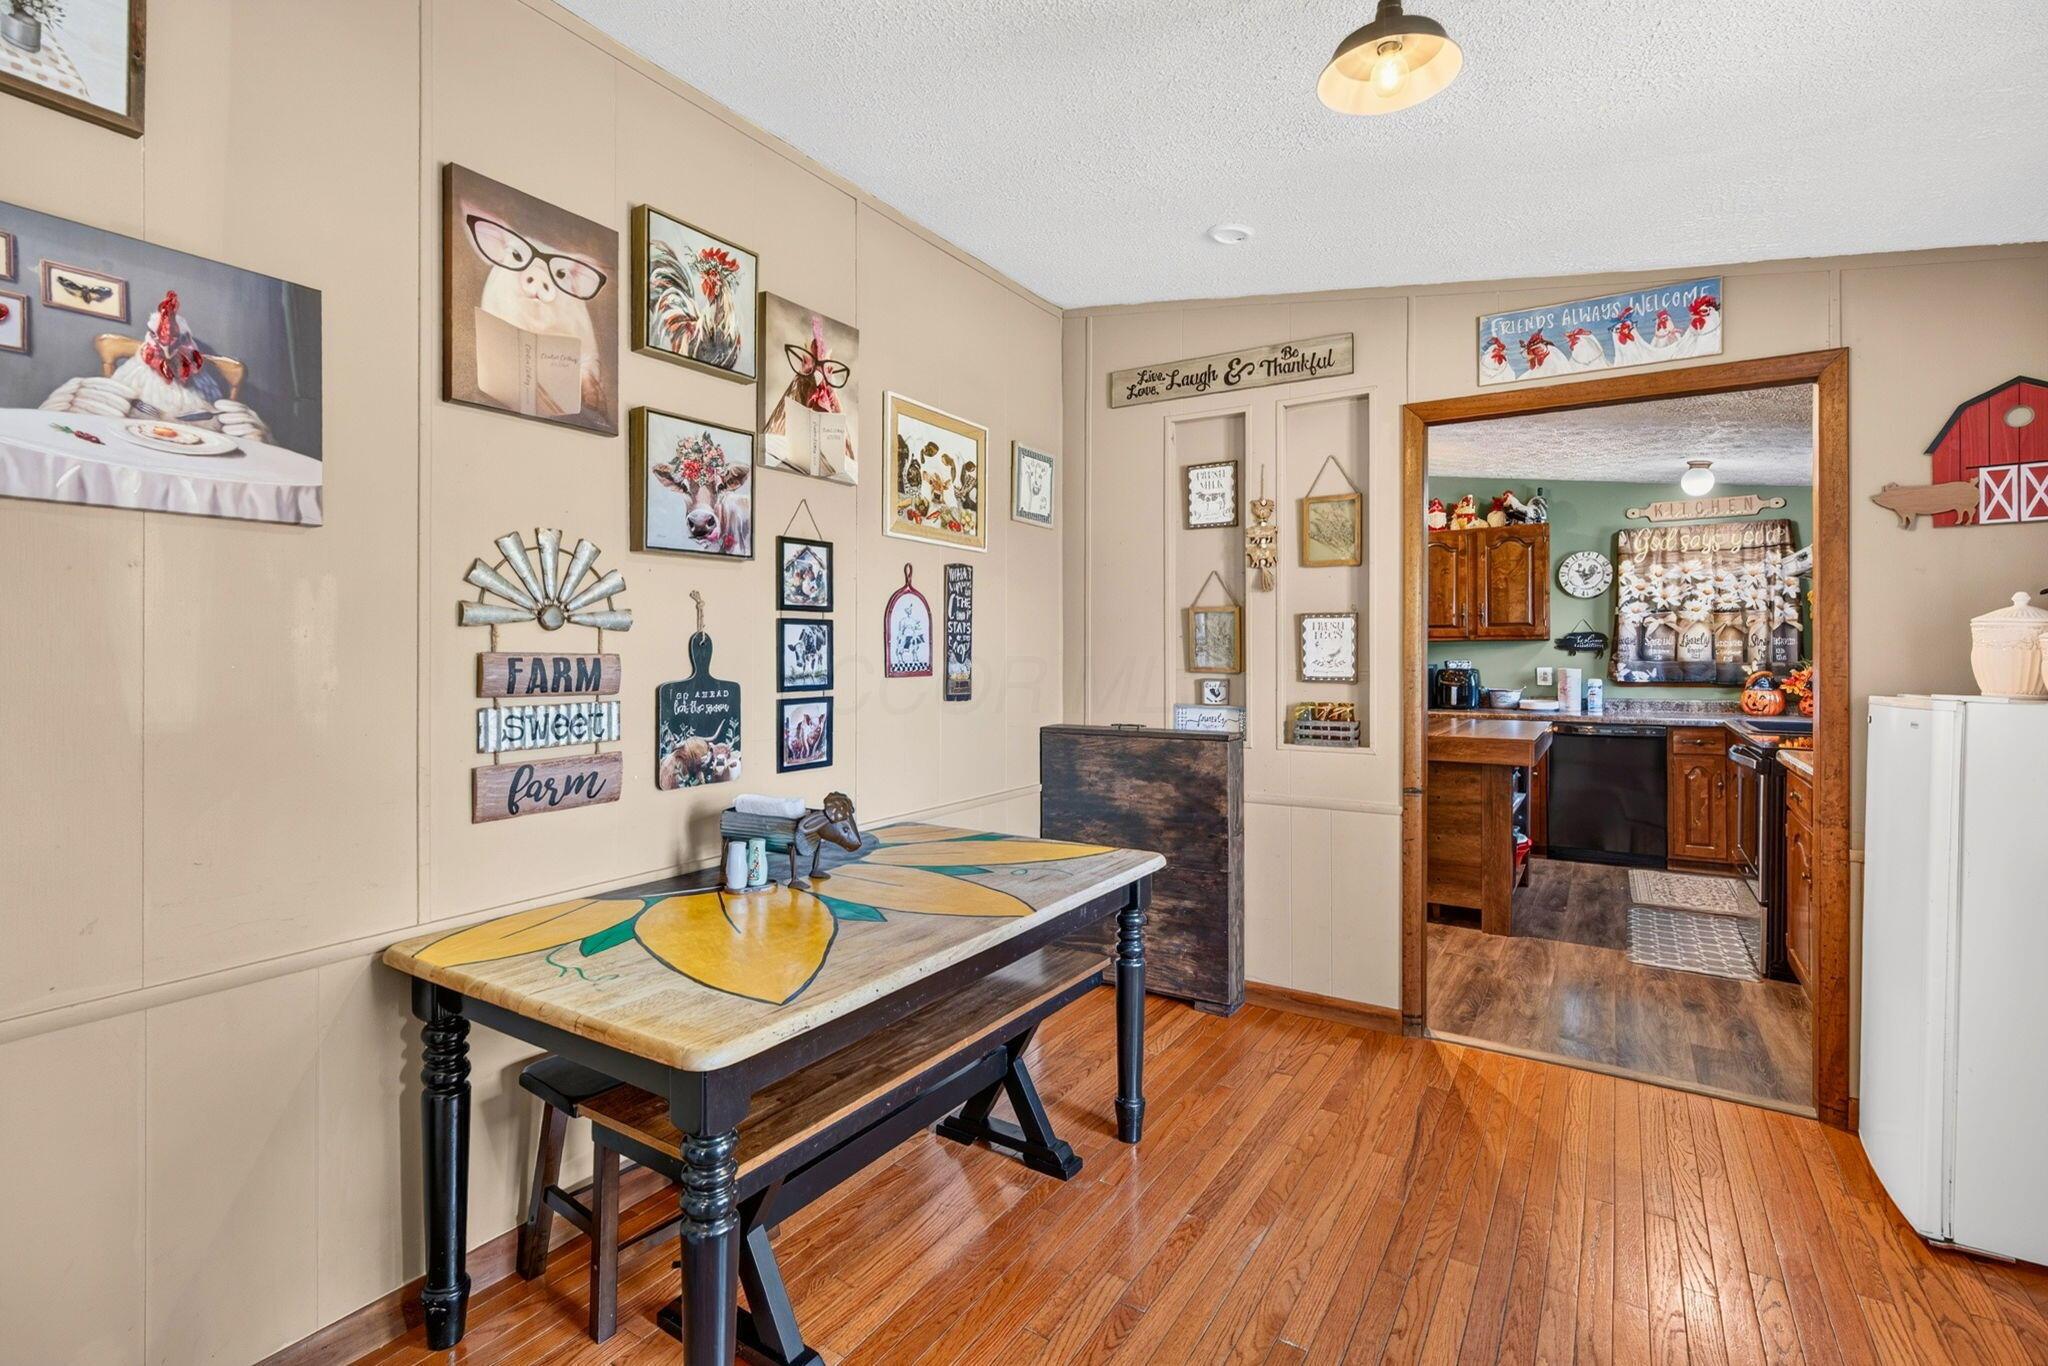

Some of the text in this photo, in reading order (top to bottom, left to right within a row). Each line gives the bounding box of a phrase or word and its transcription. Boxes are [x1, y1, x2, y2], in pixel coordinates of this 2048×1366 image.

[1490, 314, 1554, 337] FRIENDS
[1562, 302, 1622, 327] ALWAYS
[1165, 364, 1218, 392] Laugh
[1223, 357, 1256, 387] &
[1259, 348, 1336, 377] Thankful
[1280, 346, 1299, 360] Be
[1654, 497, 1754, 518] KITCHEN
[1633, 527, 1677, 562] God
[1681, 532, 1721, 554] says
[506, 657, 601, 695] FARM
[694, 689, 730, 699] AHEAD
[501, 708, 605, 742] sweet
[507, 764, 607, 815] farm
